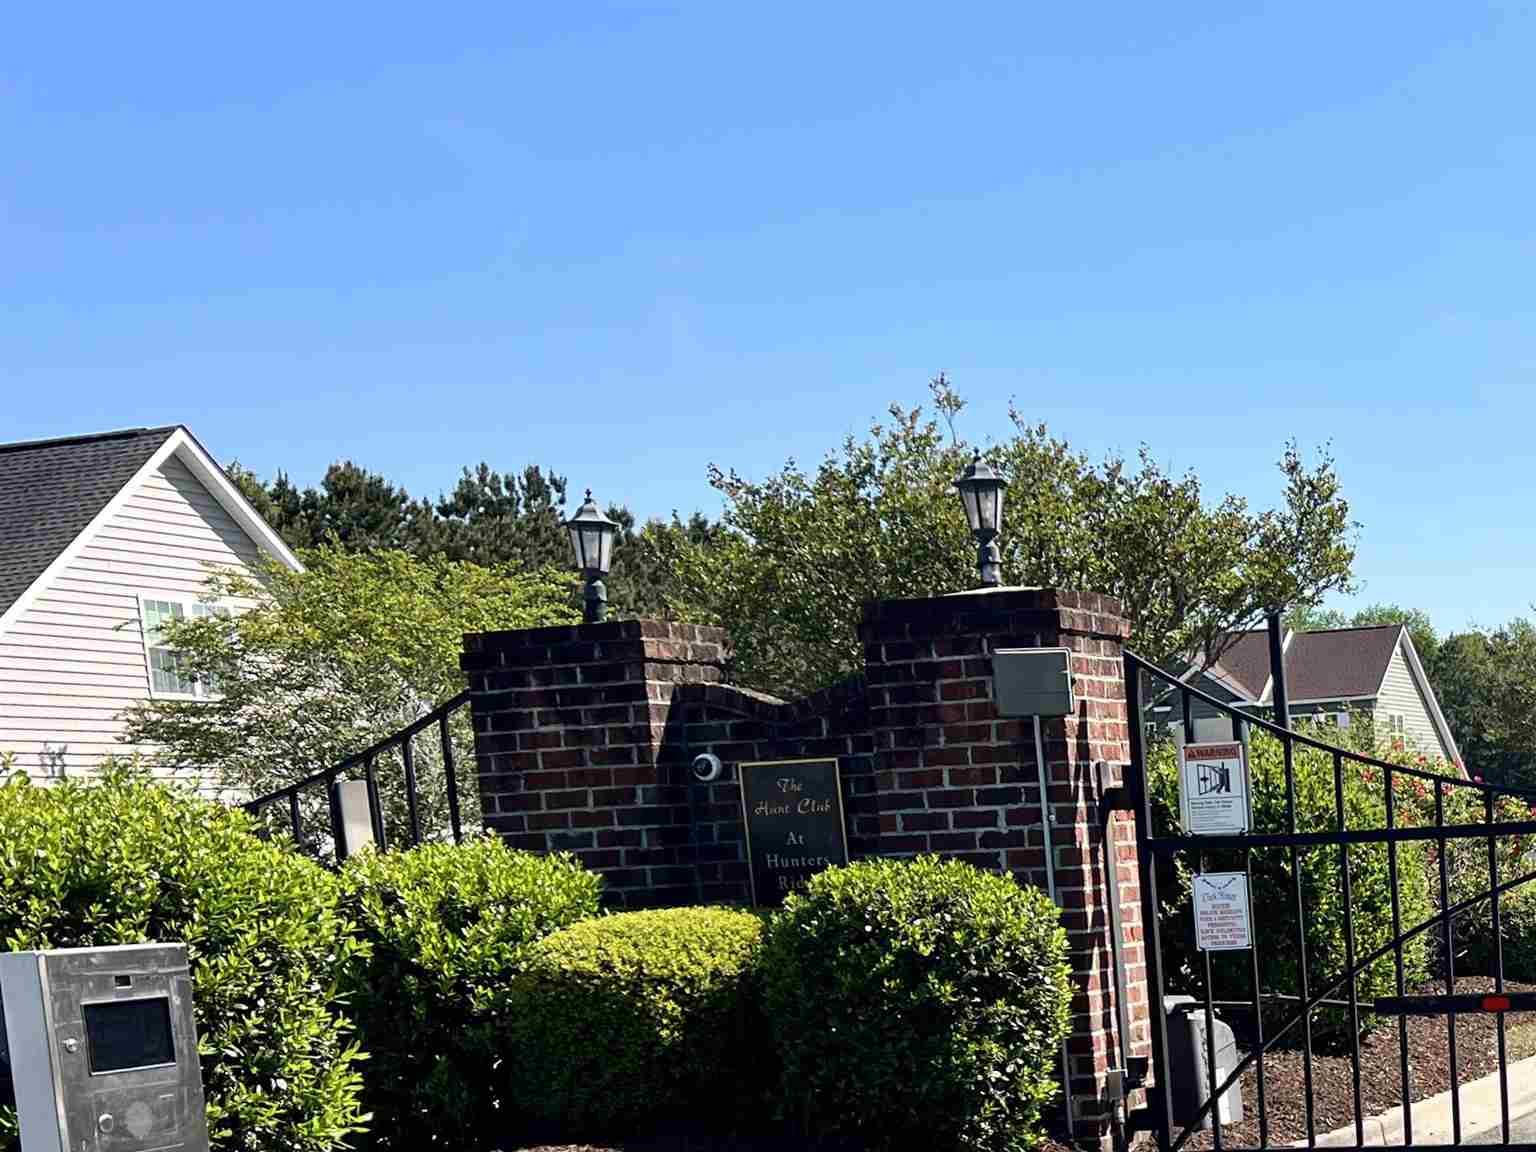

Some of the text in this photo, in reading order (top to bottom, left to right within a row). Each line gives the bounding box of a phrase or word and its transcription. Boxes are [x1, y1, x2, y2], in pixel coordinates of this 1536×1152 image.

[777, 778, 803, 793] The
[754, 798, 832, 816] Hunt Club
[786, 831, 805, 846] At
[767, 853, 830, 869] Hunters
[778, 874, 806, 890] Rid
